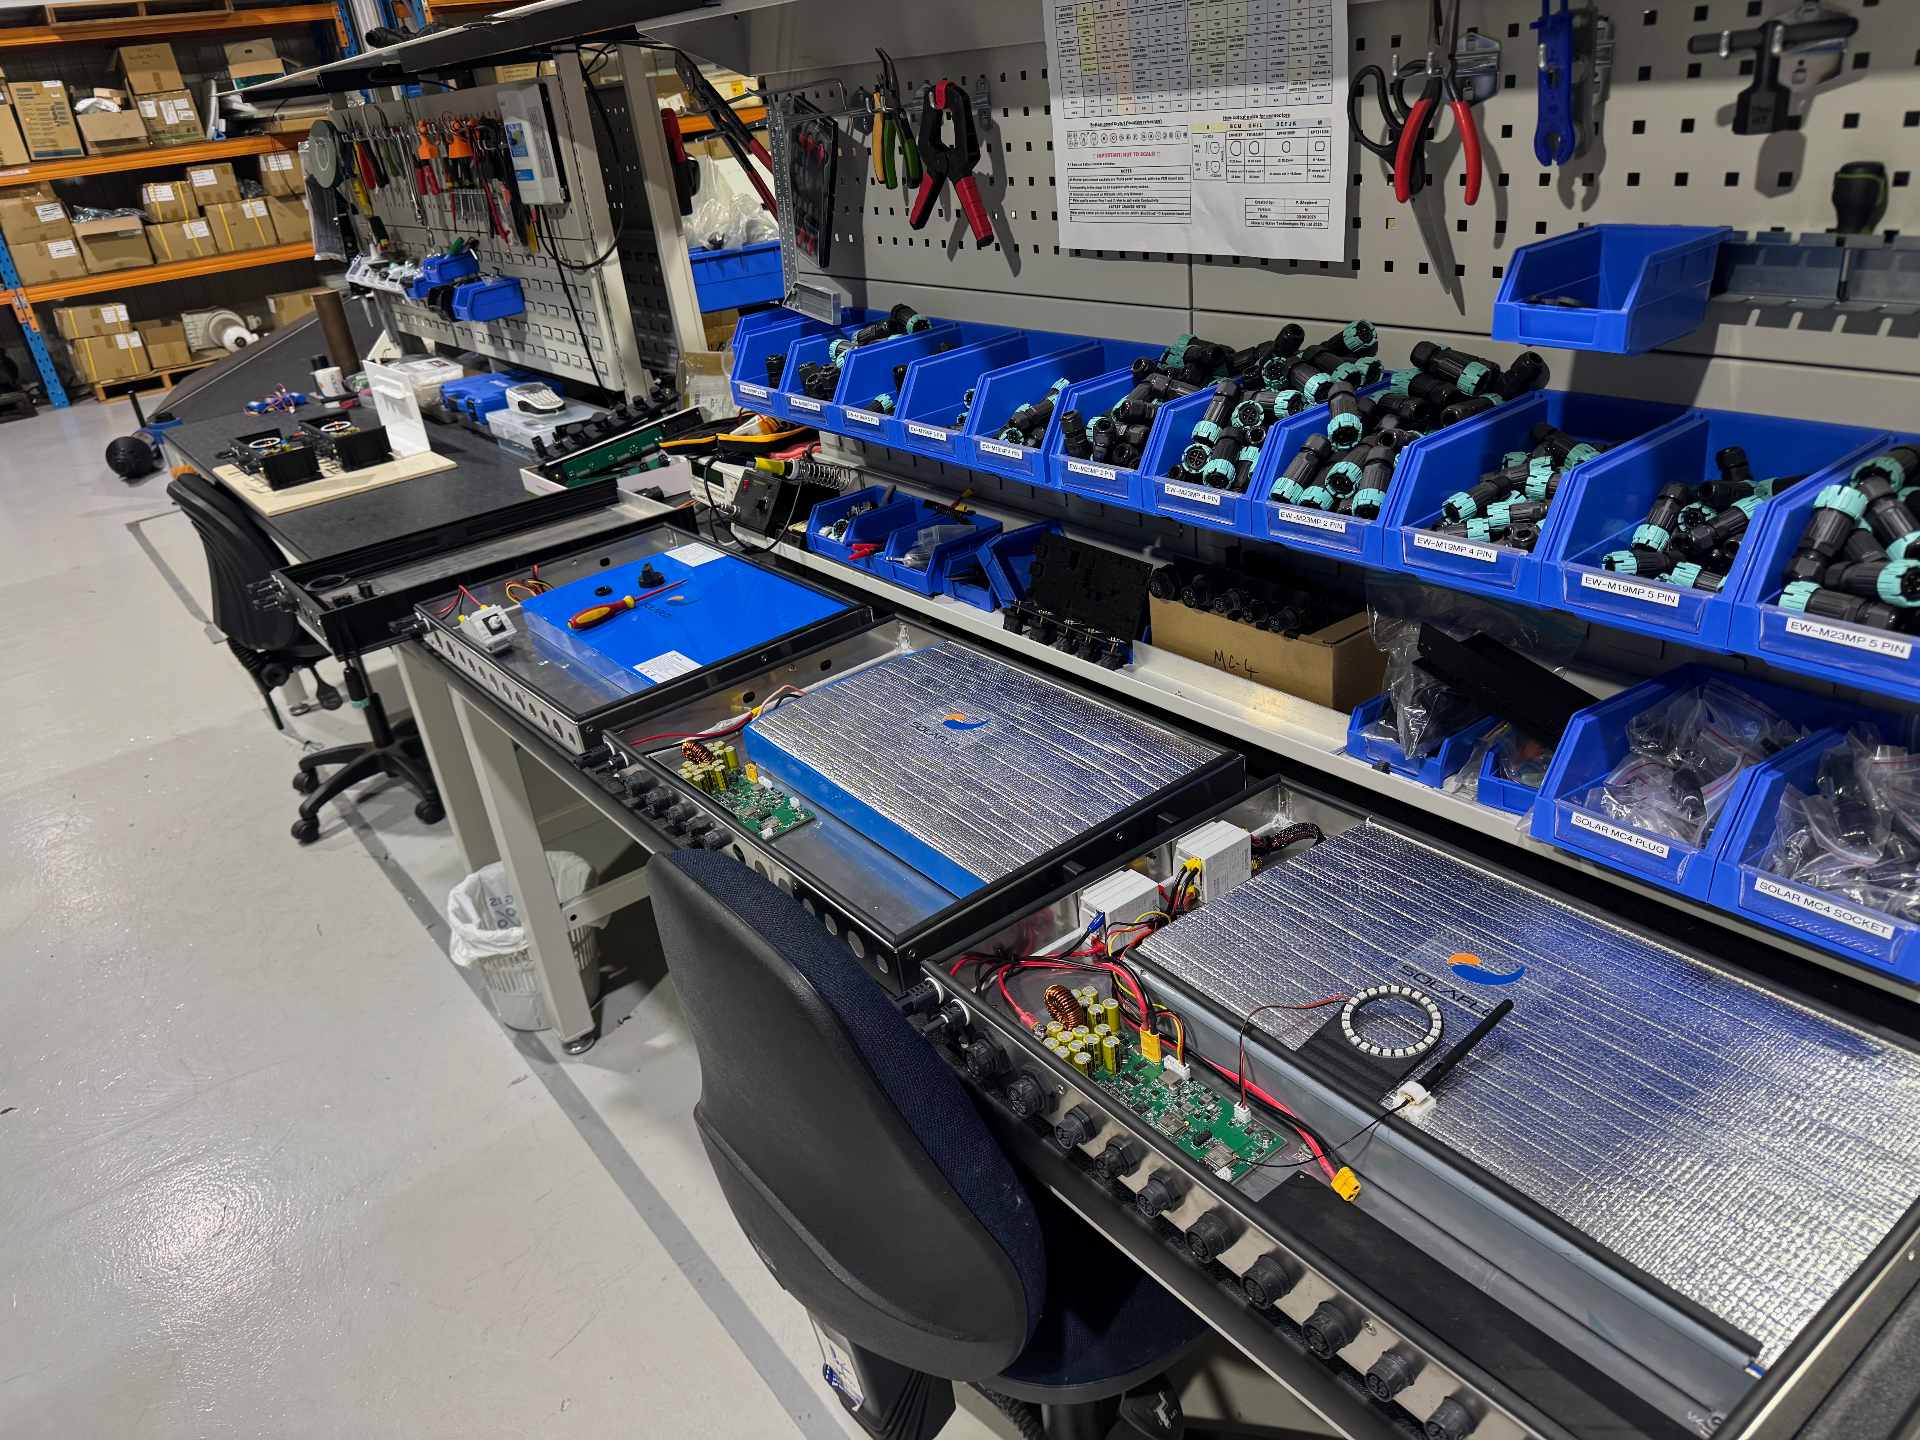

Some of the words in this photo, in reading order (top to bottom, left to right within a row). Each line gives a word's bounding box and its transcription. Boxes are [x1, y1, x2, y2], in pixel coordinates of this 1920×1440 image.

[1281, 512, 1322, 526] EW-M23MP
[1330, 521, 1343, 530] PIN
[1417, 536, 1466, 552] EW-M19MP
[1476, 549, 1492, 558] PIN
[1585, 576, 1645, 595] EW-M19MP
[1657, 593, 1676, 603] PIN
[1791, 621, 1866, 644] EW-M23MP
[1869, 640, 1878, 648] 5
[1881, 642, 1906, 654] PIN
[1575, 816, 1608, 834] SOLAR
[1611, 829, 1633, 842] MC4
[1635, 838, 1665, 854] PLUG
[1760, 881, 1801, 902] SOLAR
[1803, 898, 1831, 913] MC4
[1834, 909, 1890, 934] SOCKET
